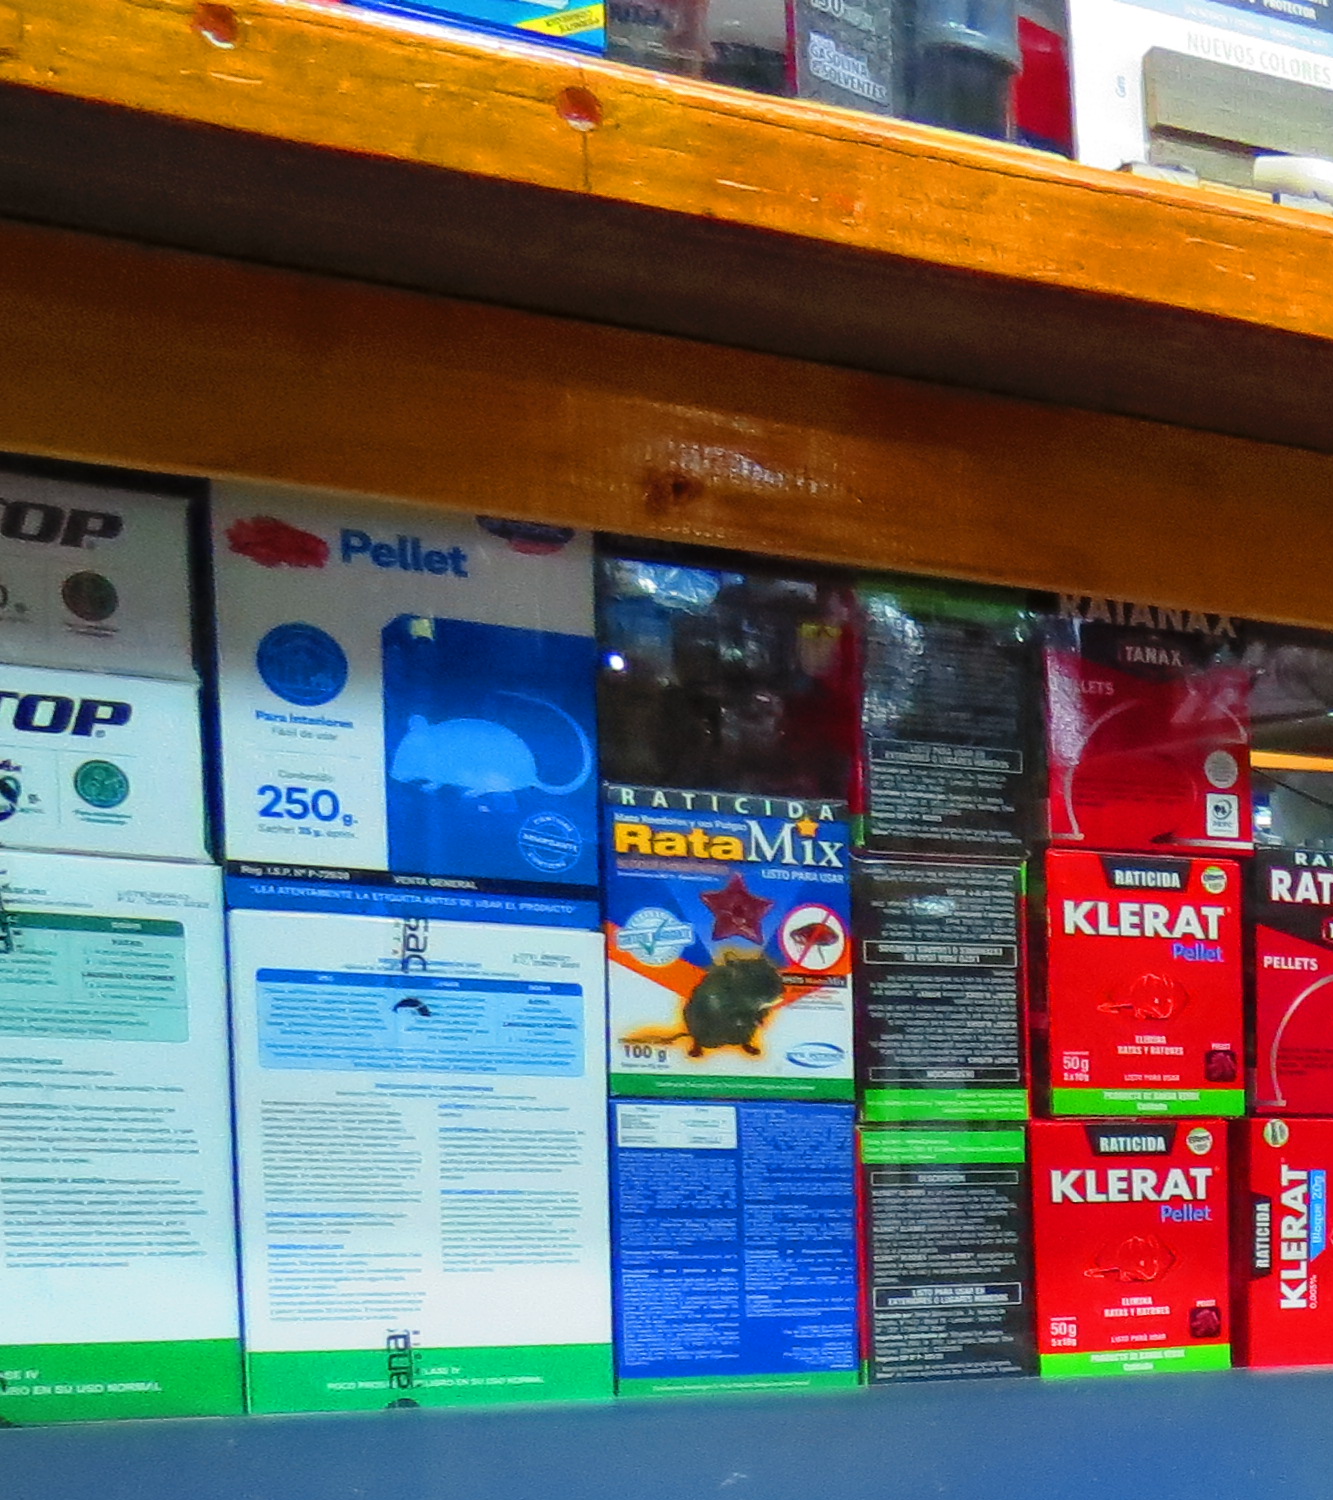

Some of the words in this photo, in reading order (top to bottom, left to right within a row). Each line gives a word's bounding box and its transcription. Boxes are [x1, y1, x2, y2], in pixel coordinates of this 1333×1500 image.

[1187, 31, 1254, 66] NUEVOS
[1260, 51, 1332, 86] COLORES
[0, 497, 124, 547] OP
[340, 527, 469, 579] Pellet
[1124, 646, 1183, 667] TANAX
[256, 784, 340, 822] 250
[620, 787, 835, 822] RATICIDA
[613, 818, 845, 869] RataMix
[1114, 869, 1181, 889] RATICIDA
[1063, 899, 1225, 940] KLERAT
[1172, 942, 1224, 963] Pellet
[1263, 955, 1319, 972] PELLETS
[624, 1044, 653, 1059] 100
[1063, 1056, 1079, 1071] 50
[1099, 1136, 1166, 1153] RATICIDA
[1050, 1166, 1213, 1203] KLERAT
[1161, 1204, 1213, 1223] Pellet
[1254, 1202, 1271, 1269] RATICIDA
[1280, 1164, 1309, 1309] KLERAT
[1050, 1322, 1068, 1336] 50
